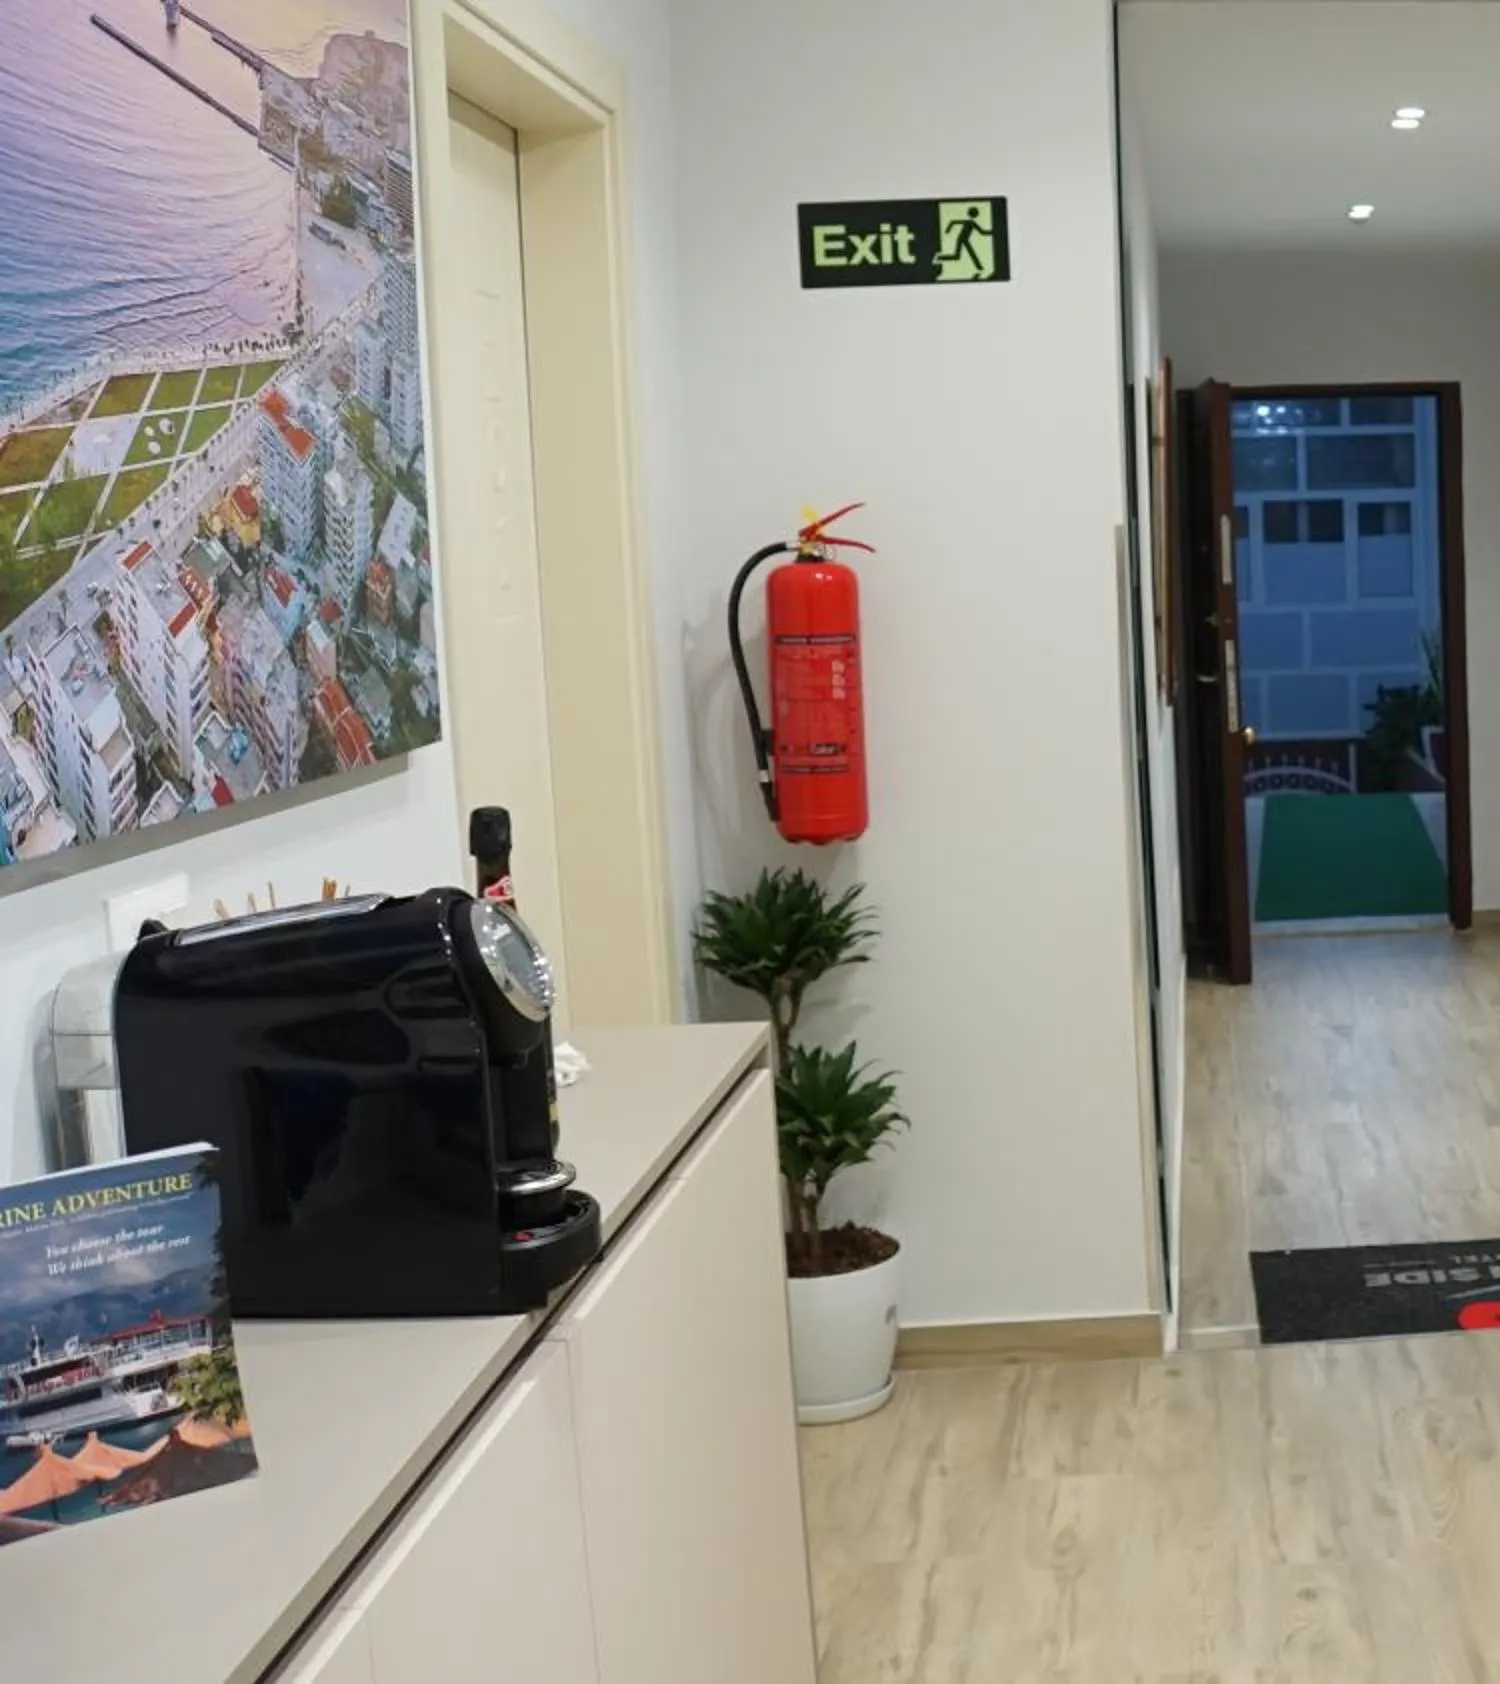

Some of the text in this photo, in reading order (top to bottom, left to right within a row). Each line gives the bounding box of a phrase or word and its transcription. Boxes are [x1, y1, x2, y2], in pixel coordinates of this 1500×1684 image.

[812, 222, 916, 267] Exit
[51, 1173, 193, 1217] ADVENTURE
[115, 1228, 135, 1243] the
[70, 1252, 103, 1271] think
[147, 1239, 166, 1254] the
[1363, 1267, 1481, 1288] SIDE
